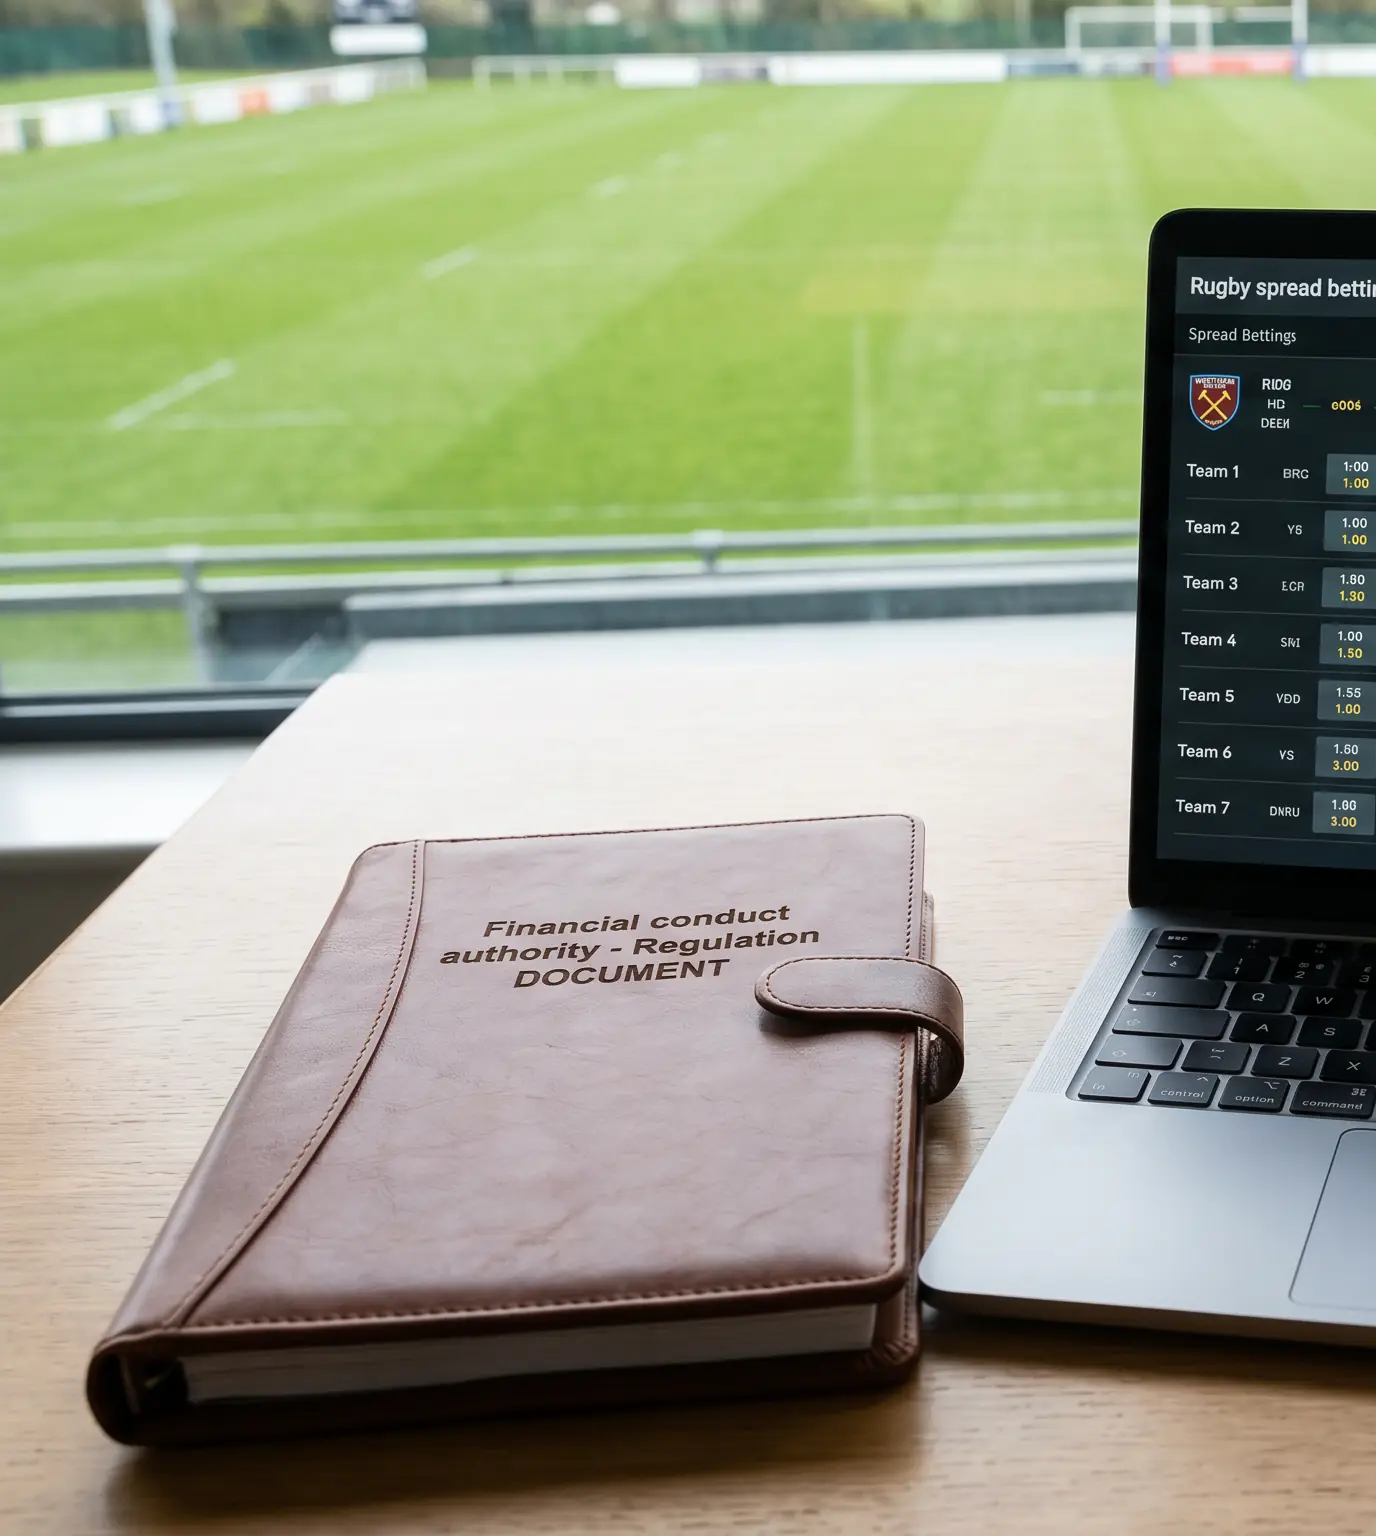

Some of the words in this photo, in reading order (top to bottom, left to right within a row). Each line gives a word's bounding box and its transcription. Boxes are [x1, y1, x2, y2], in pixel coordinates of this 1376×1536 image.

[1190, 276, 1252, 301] Rugby
[1255, 277, 1322, 301] spread
[1188, 327, 1237, 344] Spread
[1242, 328, 1297, 346] Bettings
[1186, 463, 1228, 478] Team
[1232, 464, 1239, 479] 1
[1184, 519, 1226, 534] Team
[1230, 521, 1240, 535] 2
[1342, 517, 1368, 529] 1.00
[1342, 534, 1368, 546] 1.00
[1182, 575, 1224, 590] Team
[1228, 576, 1238, 591] 3
[1181, 631, 1223, 647] Team
[1226, 633, 1237, 647] 4
[1337, 630, 1363, 642] 1.00
[1337, 647, 1363, 659] 1.50
[1179, 687, 1220, 702] Team
[1225, 689, 1235, 703] 5
[1335, 703, 1361, 715] 1.00
[1177, 743, 1219, 759] Team
[1222, 745, 1232, 759] 6
[1332, 760, 1360, 772] 3.00
[1175, 798, 1217, 814] Team
[1221, 800, 1231, 815] 7
[1330, 815, 1357, 828] 3.00
[482, 913, 639, 937] Financial
[650, 905, 790, 930] conduct
[440, 941, 601, 964] authority
[633, 929, 820, 956] Regulation
[513, 959, 730, 988] DOCUMENT
[1294, 970, 1306, 979] 2
[1358, 974, 1370, 983] 3
[1251, 992, 1265, 1002] Q
[1315, 996, 1334, 1005] W
[1255, 1023, 1269, 1032] A
[1323, 1027, 1336, 1036] S
[1278, 1056, 1292, 1066] Z
[1346, 1061, 1361, 1071] X
[1160, 1090, 1205, 1098] control
[1234, 1095, 1274, 1104] option
